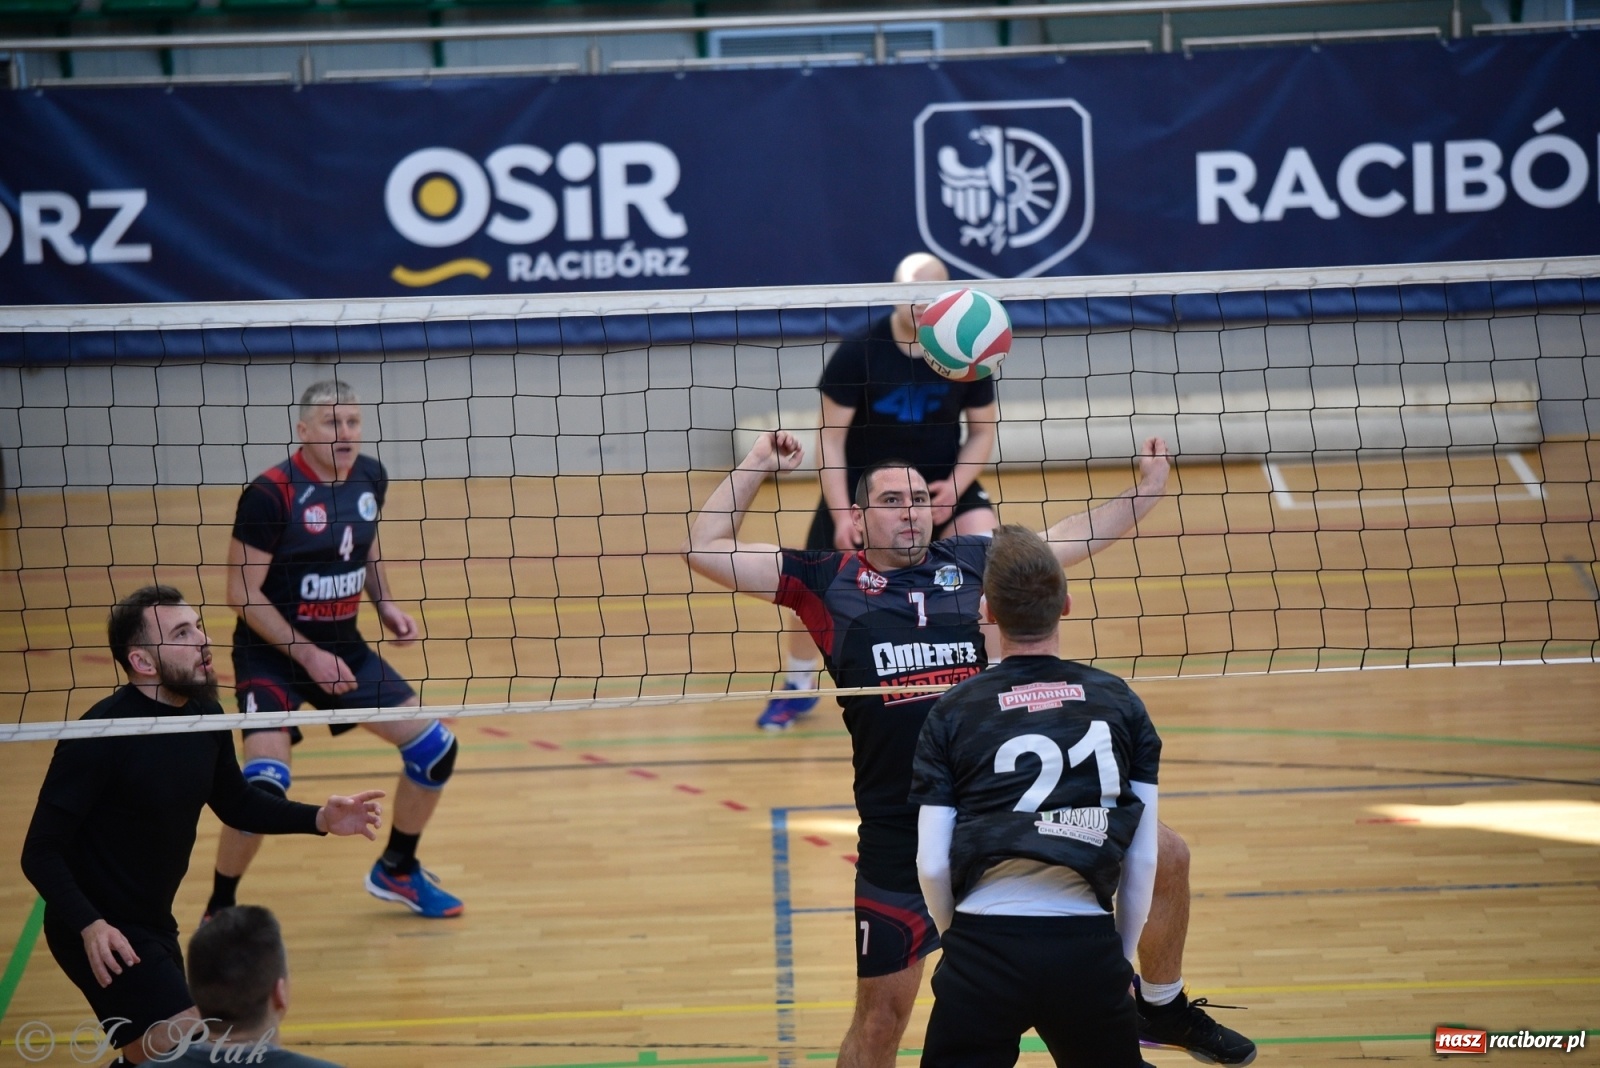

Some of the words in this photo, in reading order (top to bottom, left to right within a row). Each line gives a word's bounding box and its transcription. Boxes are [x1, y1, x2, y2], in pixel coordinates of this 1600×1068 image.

[1196, 107, 1600, 225] RACIBÓ
[0, 188, 152, 265] RZ
[508, 241, 690, 282] RACIBÓRZ
[339, 525, 354, 561] 4
[908, 592, 927, 627] 7
[1004, 688, 1079, 706] PIWIARNIA
[994, 720, 1121, 813] 21
[1039, 826, 1060, 835] CHILL
[1069, 830, 1103, 846] SLEEPING
[860, 920, 870, 956] 7
